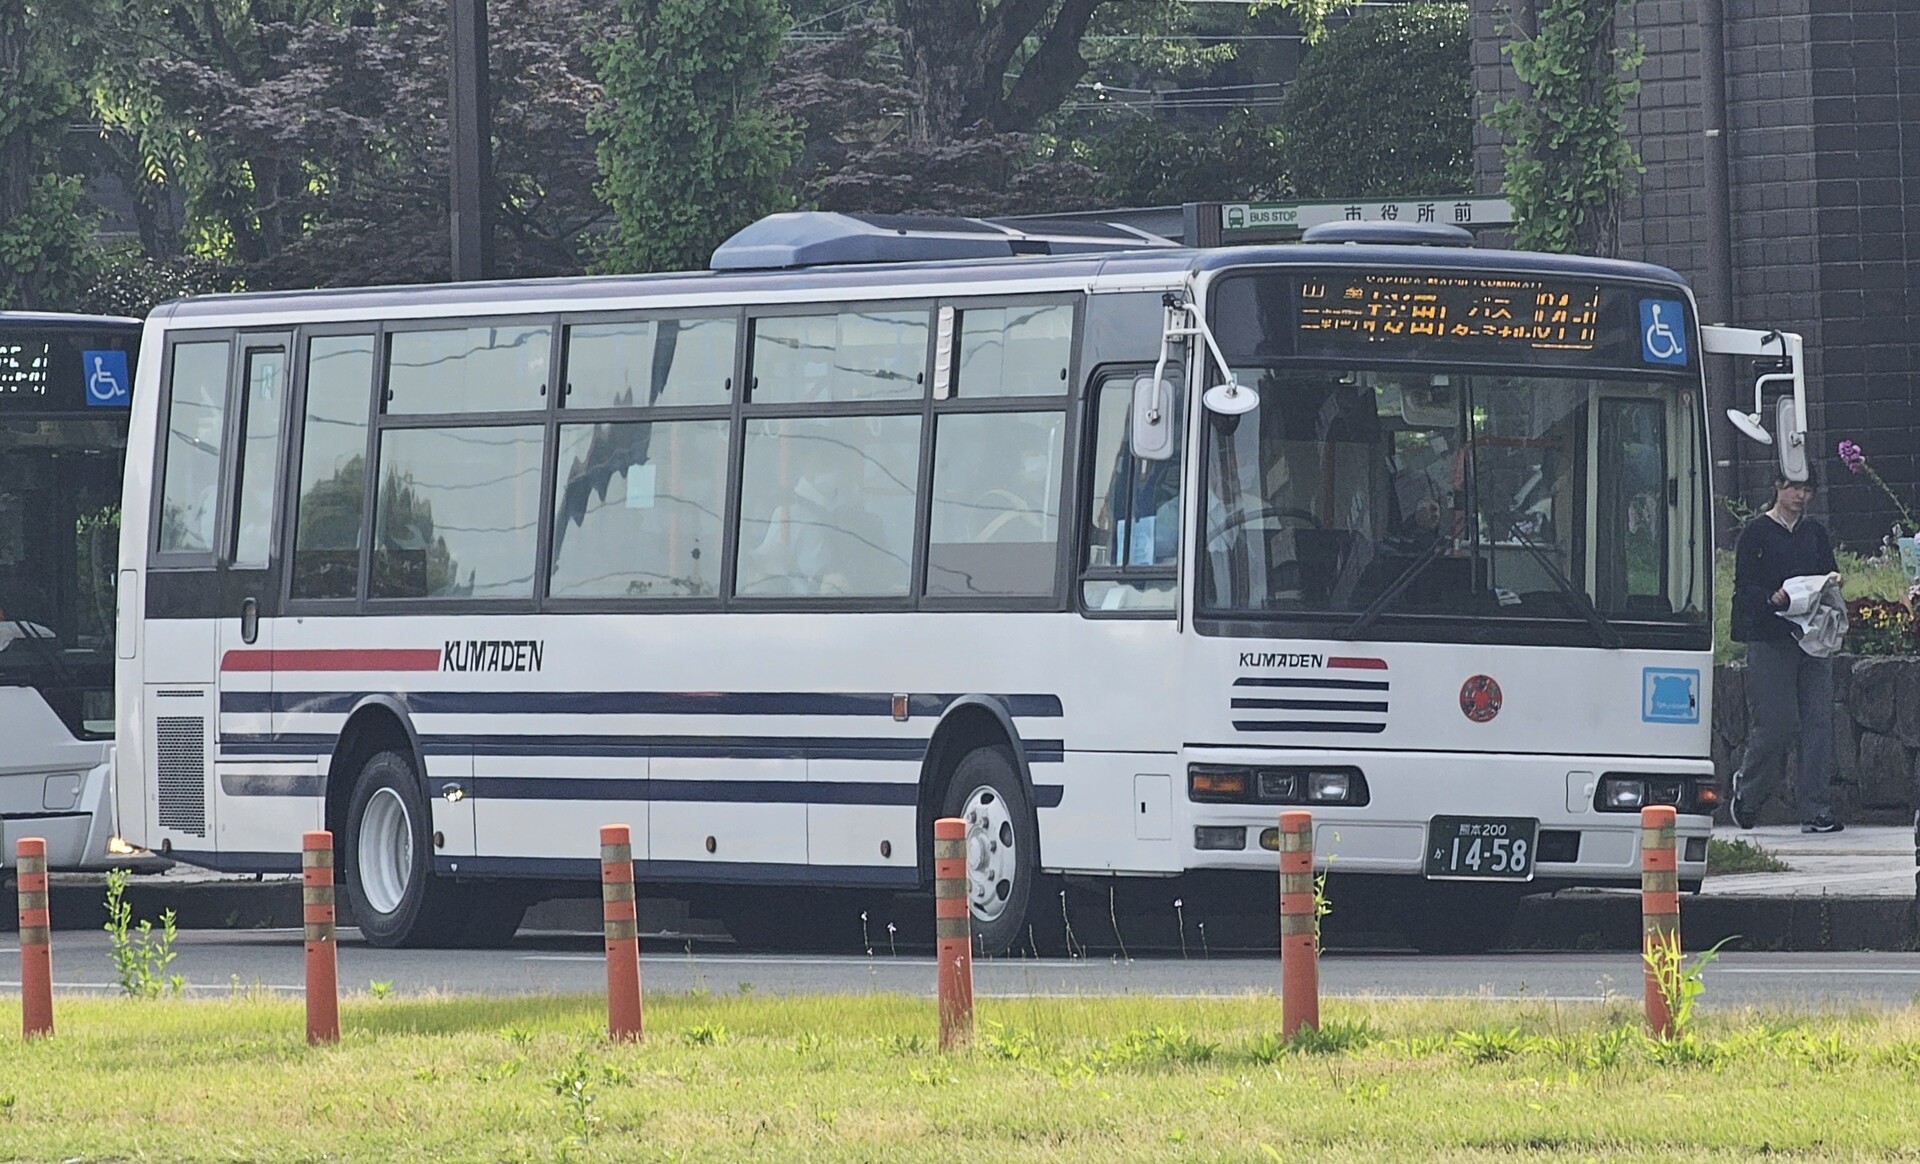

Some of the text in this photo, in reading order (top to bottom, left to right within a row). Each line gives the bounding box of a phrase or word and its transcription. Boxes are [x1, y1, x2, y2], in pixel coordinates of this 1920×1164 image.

[1250, 211, 1297, 222] BUS STOP
[1345, 203, 1472, 222] 市役所前
[443, 640, 544, 672] KUMADEN
[1239, 653, 1323, 668] KUMADEN
[1450, 838, 1527, 872] 14-58
